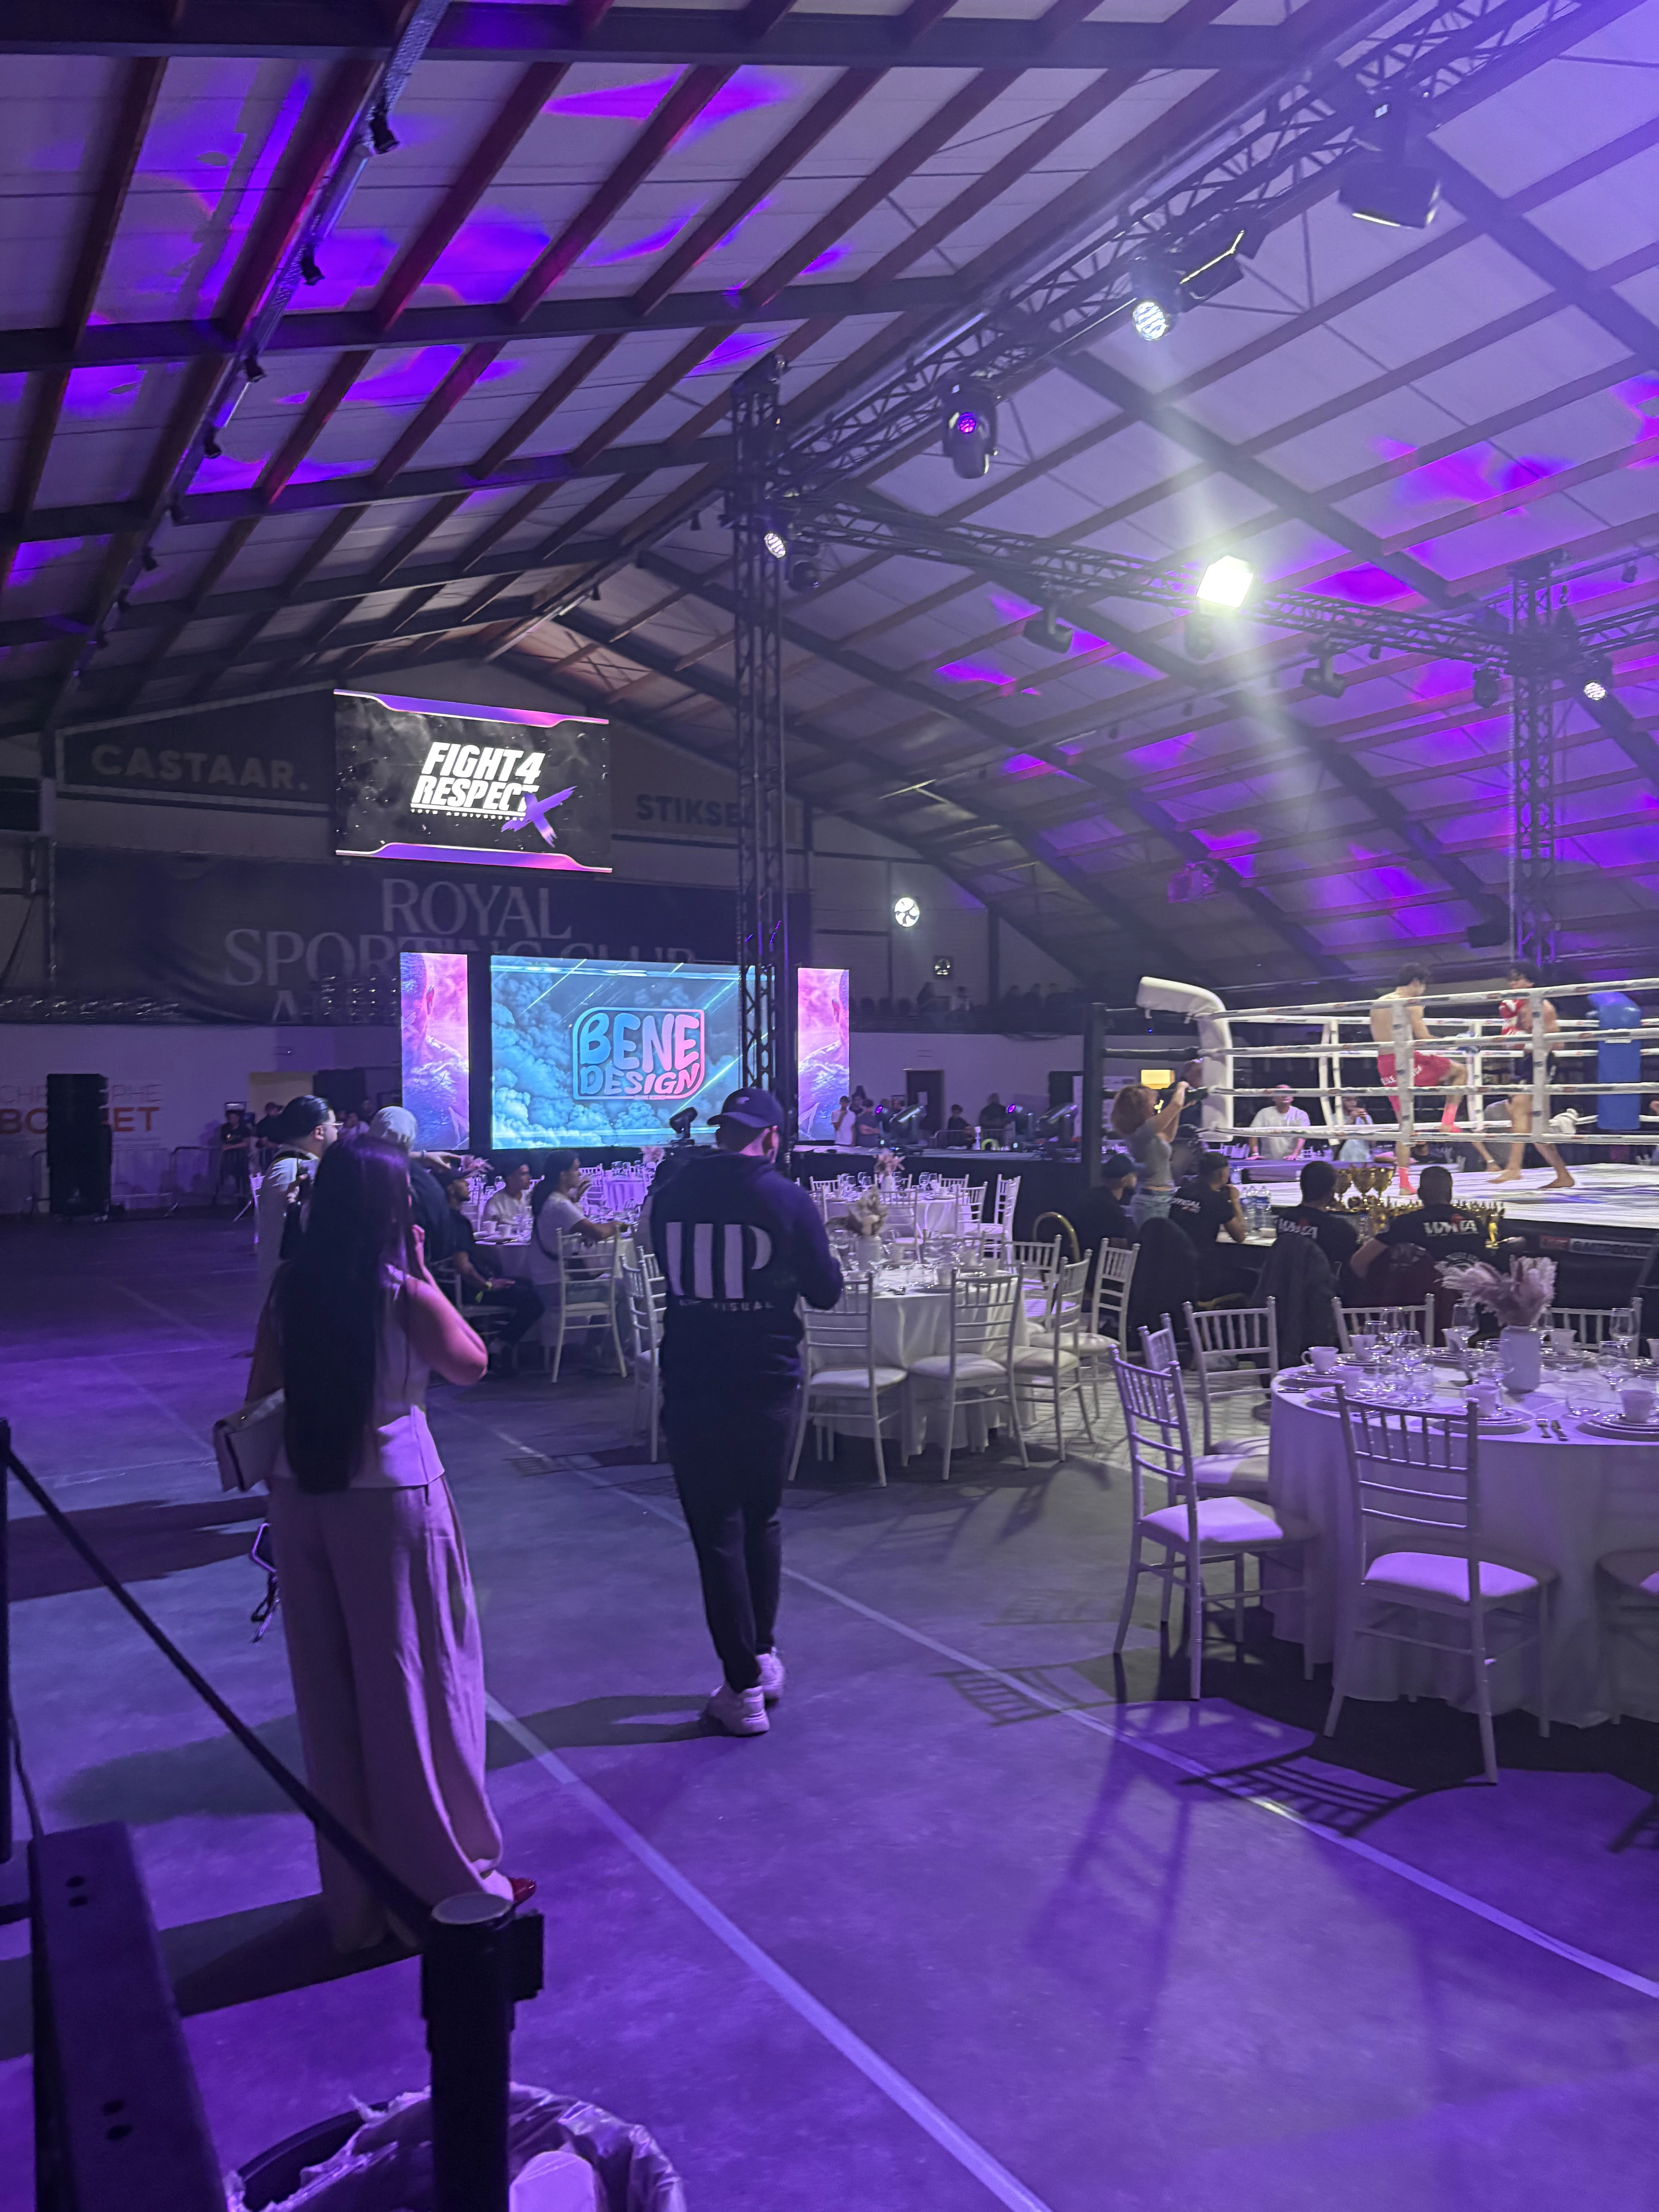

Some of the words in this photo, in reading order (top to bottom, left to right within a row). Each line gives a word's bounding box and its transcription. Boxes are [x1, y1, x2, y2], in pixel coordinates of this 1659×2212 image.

[91, 744, 309, 792] CASTAAR.
[411, 776, 540, 812] RESPECT
[382, 879, 572, 940] ROYAL
[580, 1013, 699, 1073] BENE
[580, 1063, 700, 1095] DESIGN
